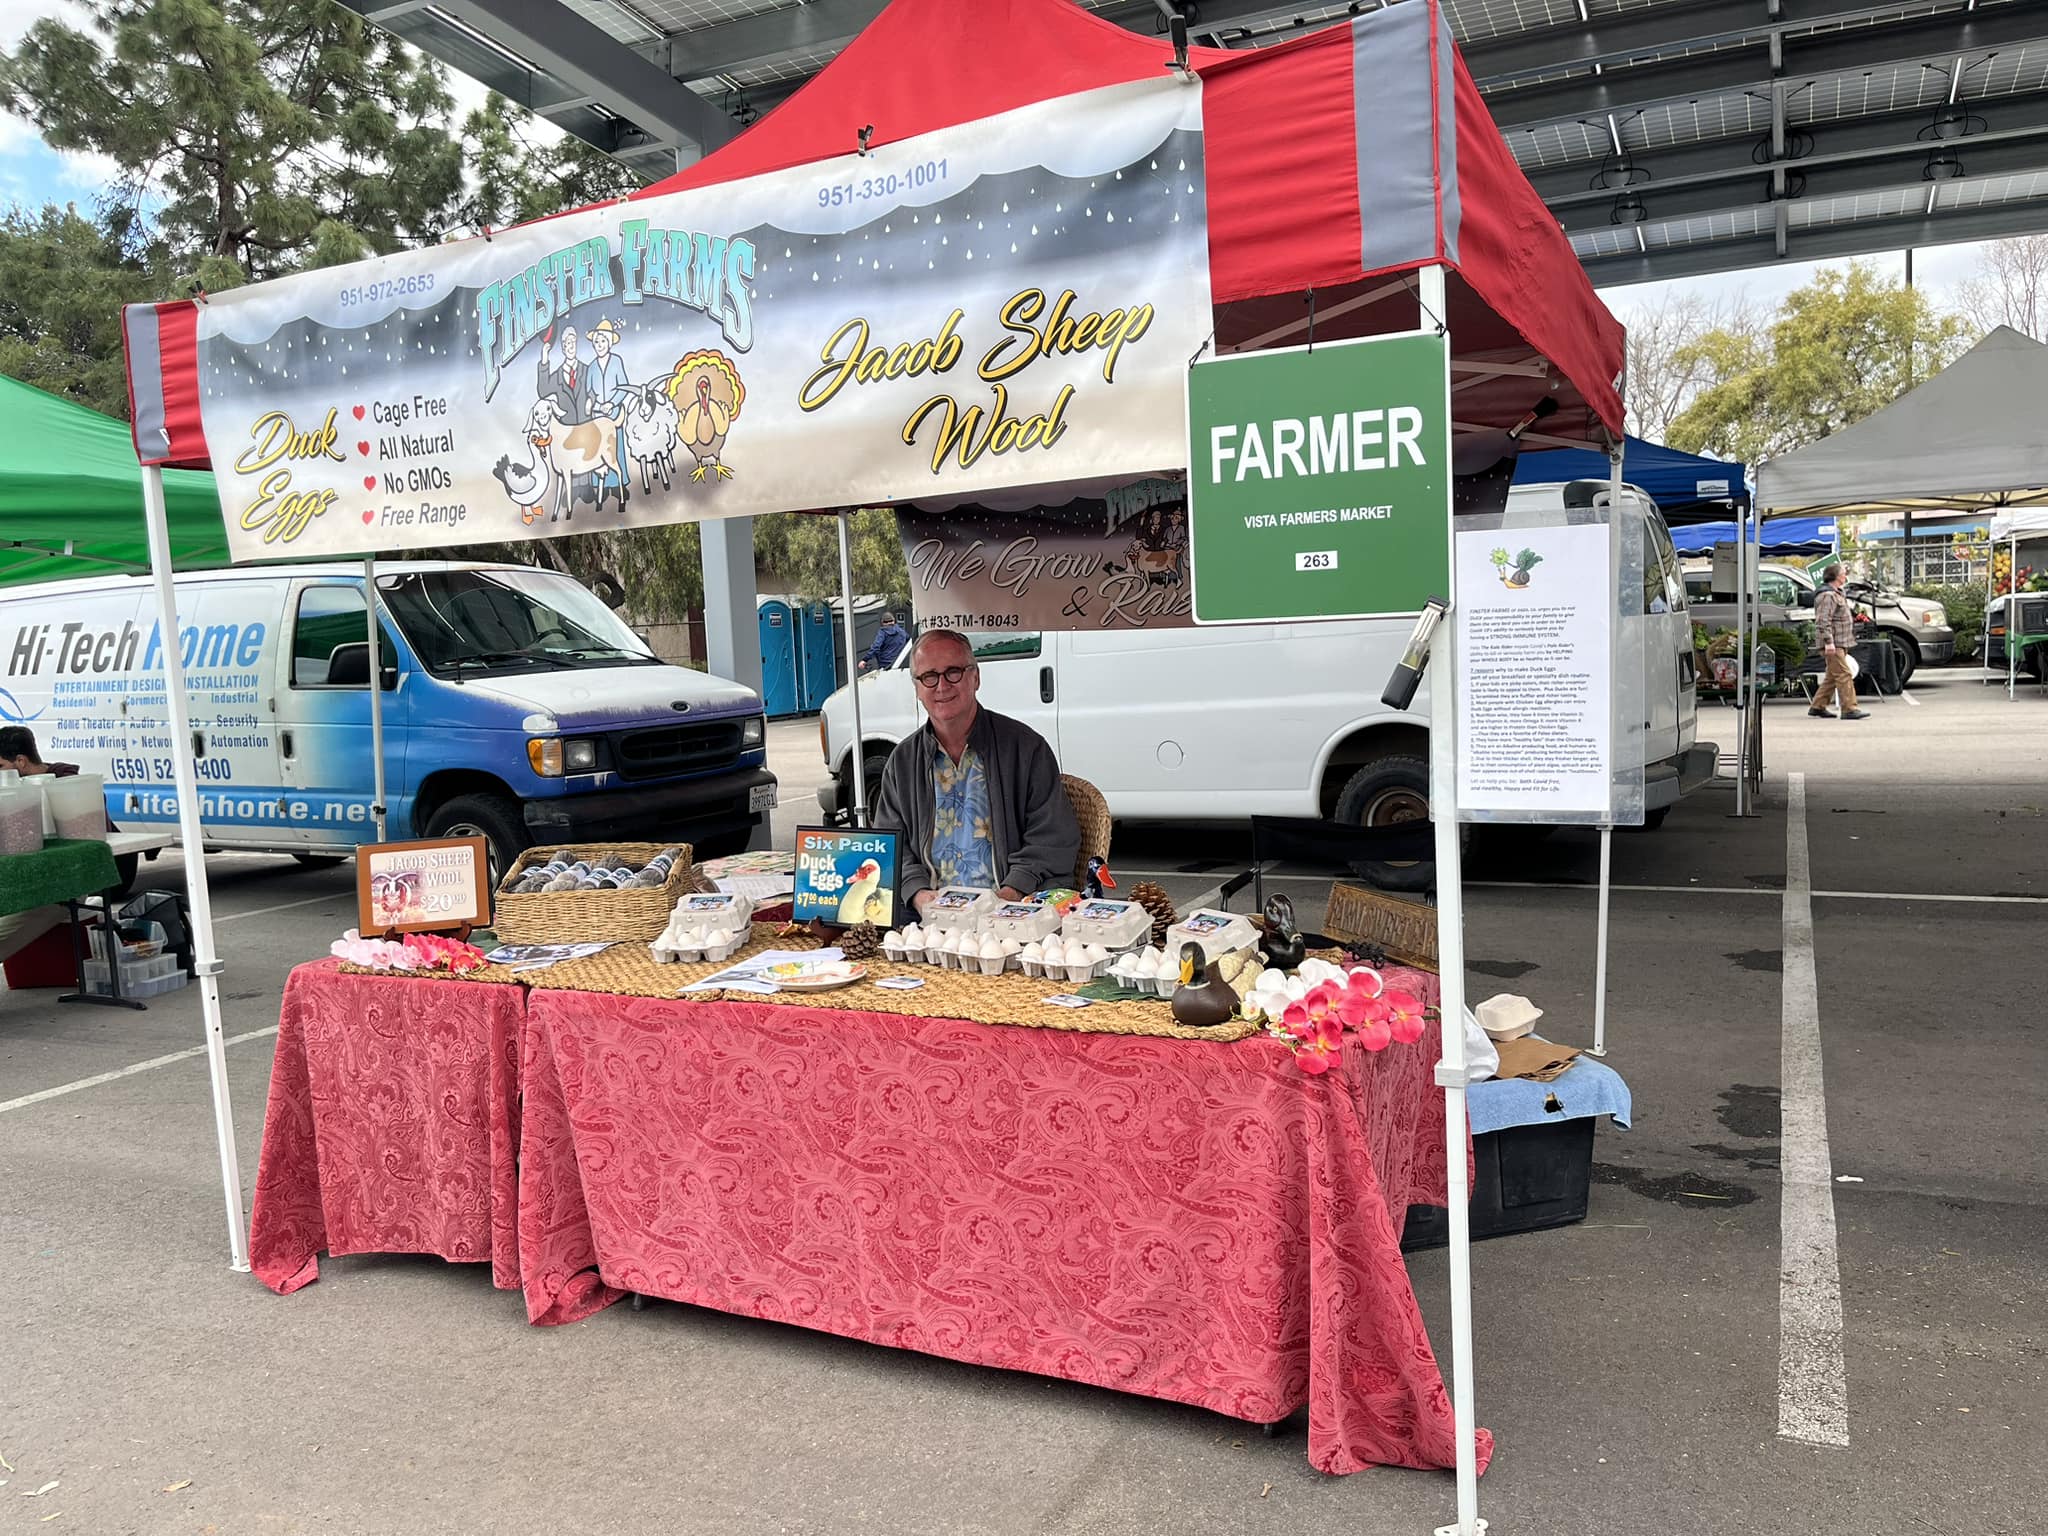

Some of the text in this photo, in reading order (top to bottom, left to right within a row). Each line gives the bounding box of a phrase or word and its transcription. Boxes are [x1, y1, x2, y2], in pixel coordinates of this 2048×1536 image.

[818, 158, 950, 208] 951-330-1001
[340, 273, 435, 308] 951-972-2653
[477, 219, 756, 402] FINSTER FARMS
[799, 288, 1155, 412] Jacob Sheep
[373, 395, 448, 427] Cage Free
[234, 406, 346, 475] Duck
[901, 383, 1076, 475] Wool
[378, 429, 454, 461] All Natural
[1210, 405, 1427, 484] FARMER
[383, 471, 452, 496] No GMOs
[240, 468, 342, 543] Eggs
[380, 502, 467, 529] Free Range
[1244, 505, 1393, 529] VISTA FARMERS MARKET
[909, 536, 1103, 598] We Grow
[1303, 554, 1330, 568] 263
[1062, 586, 1095, 617] &
[930, 614, 1019, 628] #33-TM-18043
[8, 620, 141, 676] Hi-Tech
[53, 697, 97, 708] Residential
[211, 692, 258, 704] Industrial
[54, 680, 129, 694] ENTERTAINMENT
[57, 713, 258, 730] Home Theater Audio Security
[50, 736, 95, 749] Structured
[98, 735, 127, 751] Wiring
[211, 735, 269, 748] Automation
[111, 757, 150, 781] (559)
[804, 836, 887, 853] Six Pack
[800, 853, 837, 871] Duck
[809, 869, 844, 892] Eggs
[818, 895, 838, 906] each
